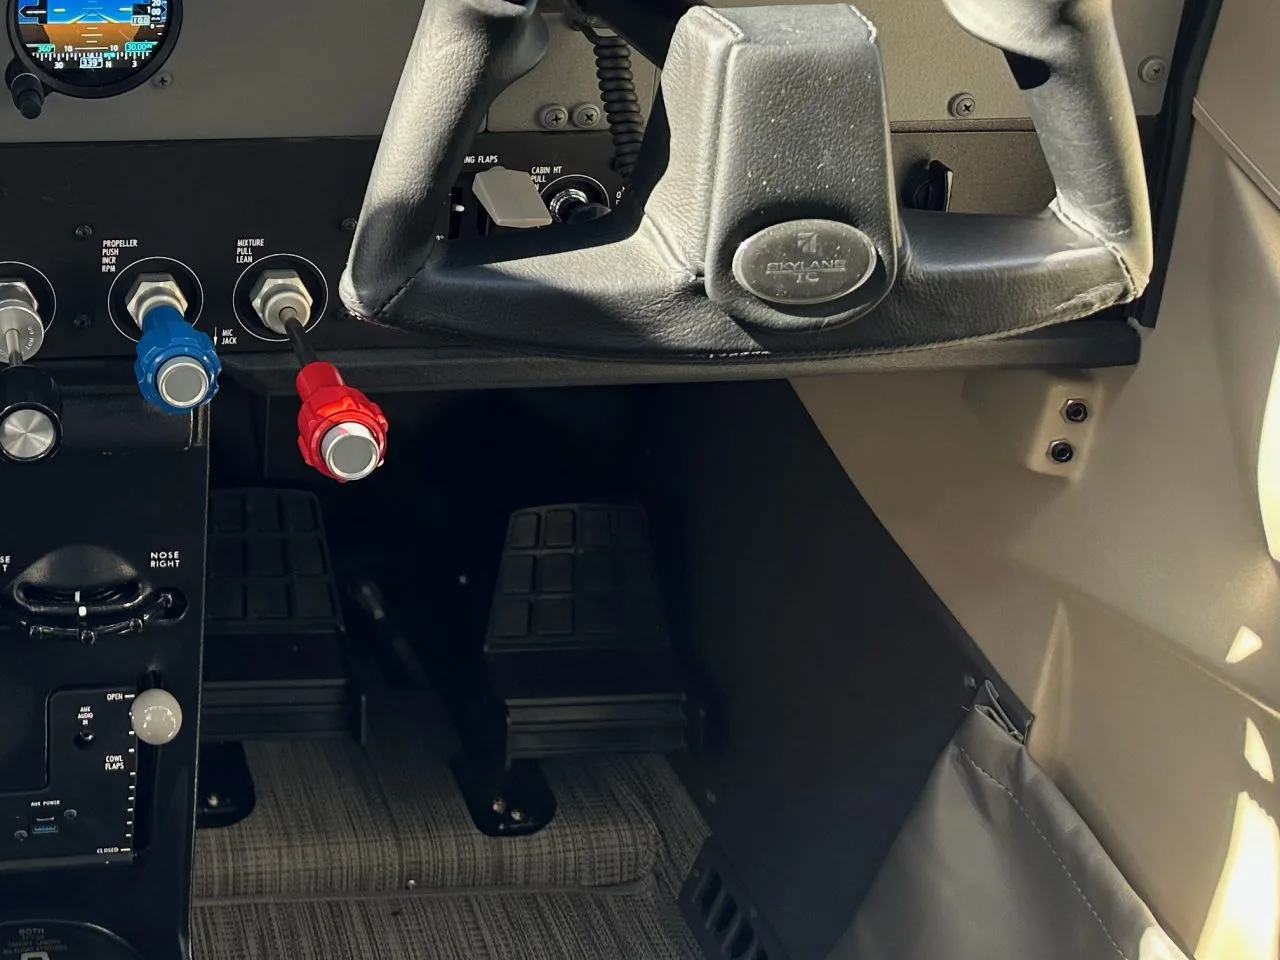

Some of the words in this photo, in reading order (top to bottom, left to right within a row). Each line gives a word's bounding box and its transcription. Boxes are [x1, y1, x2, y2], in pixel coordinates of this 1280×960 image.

[478, 155, 498, 164] FLAPS
[532, 166, 550, 175] CABIN
[553, 166, 562, 174] HT
[236, 256, 252, 264] LEAN
[222, 337, 237, 345] JACK
[150, 552, 179, 560] NOSE
[150, 559, 180, 568] RIGHT
[106, 756, 122, 764] COWL
[105, 762, 124, 770] FLAPS
